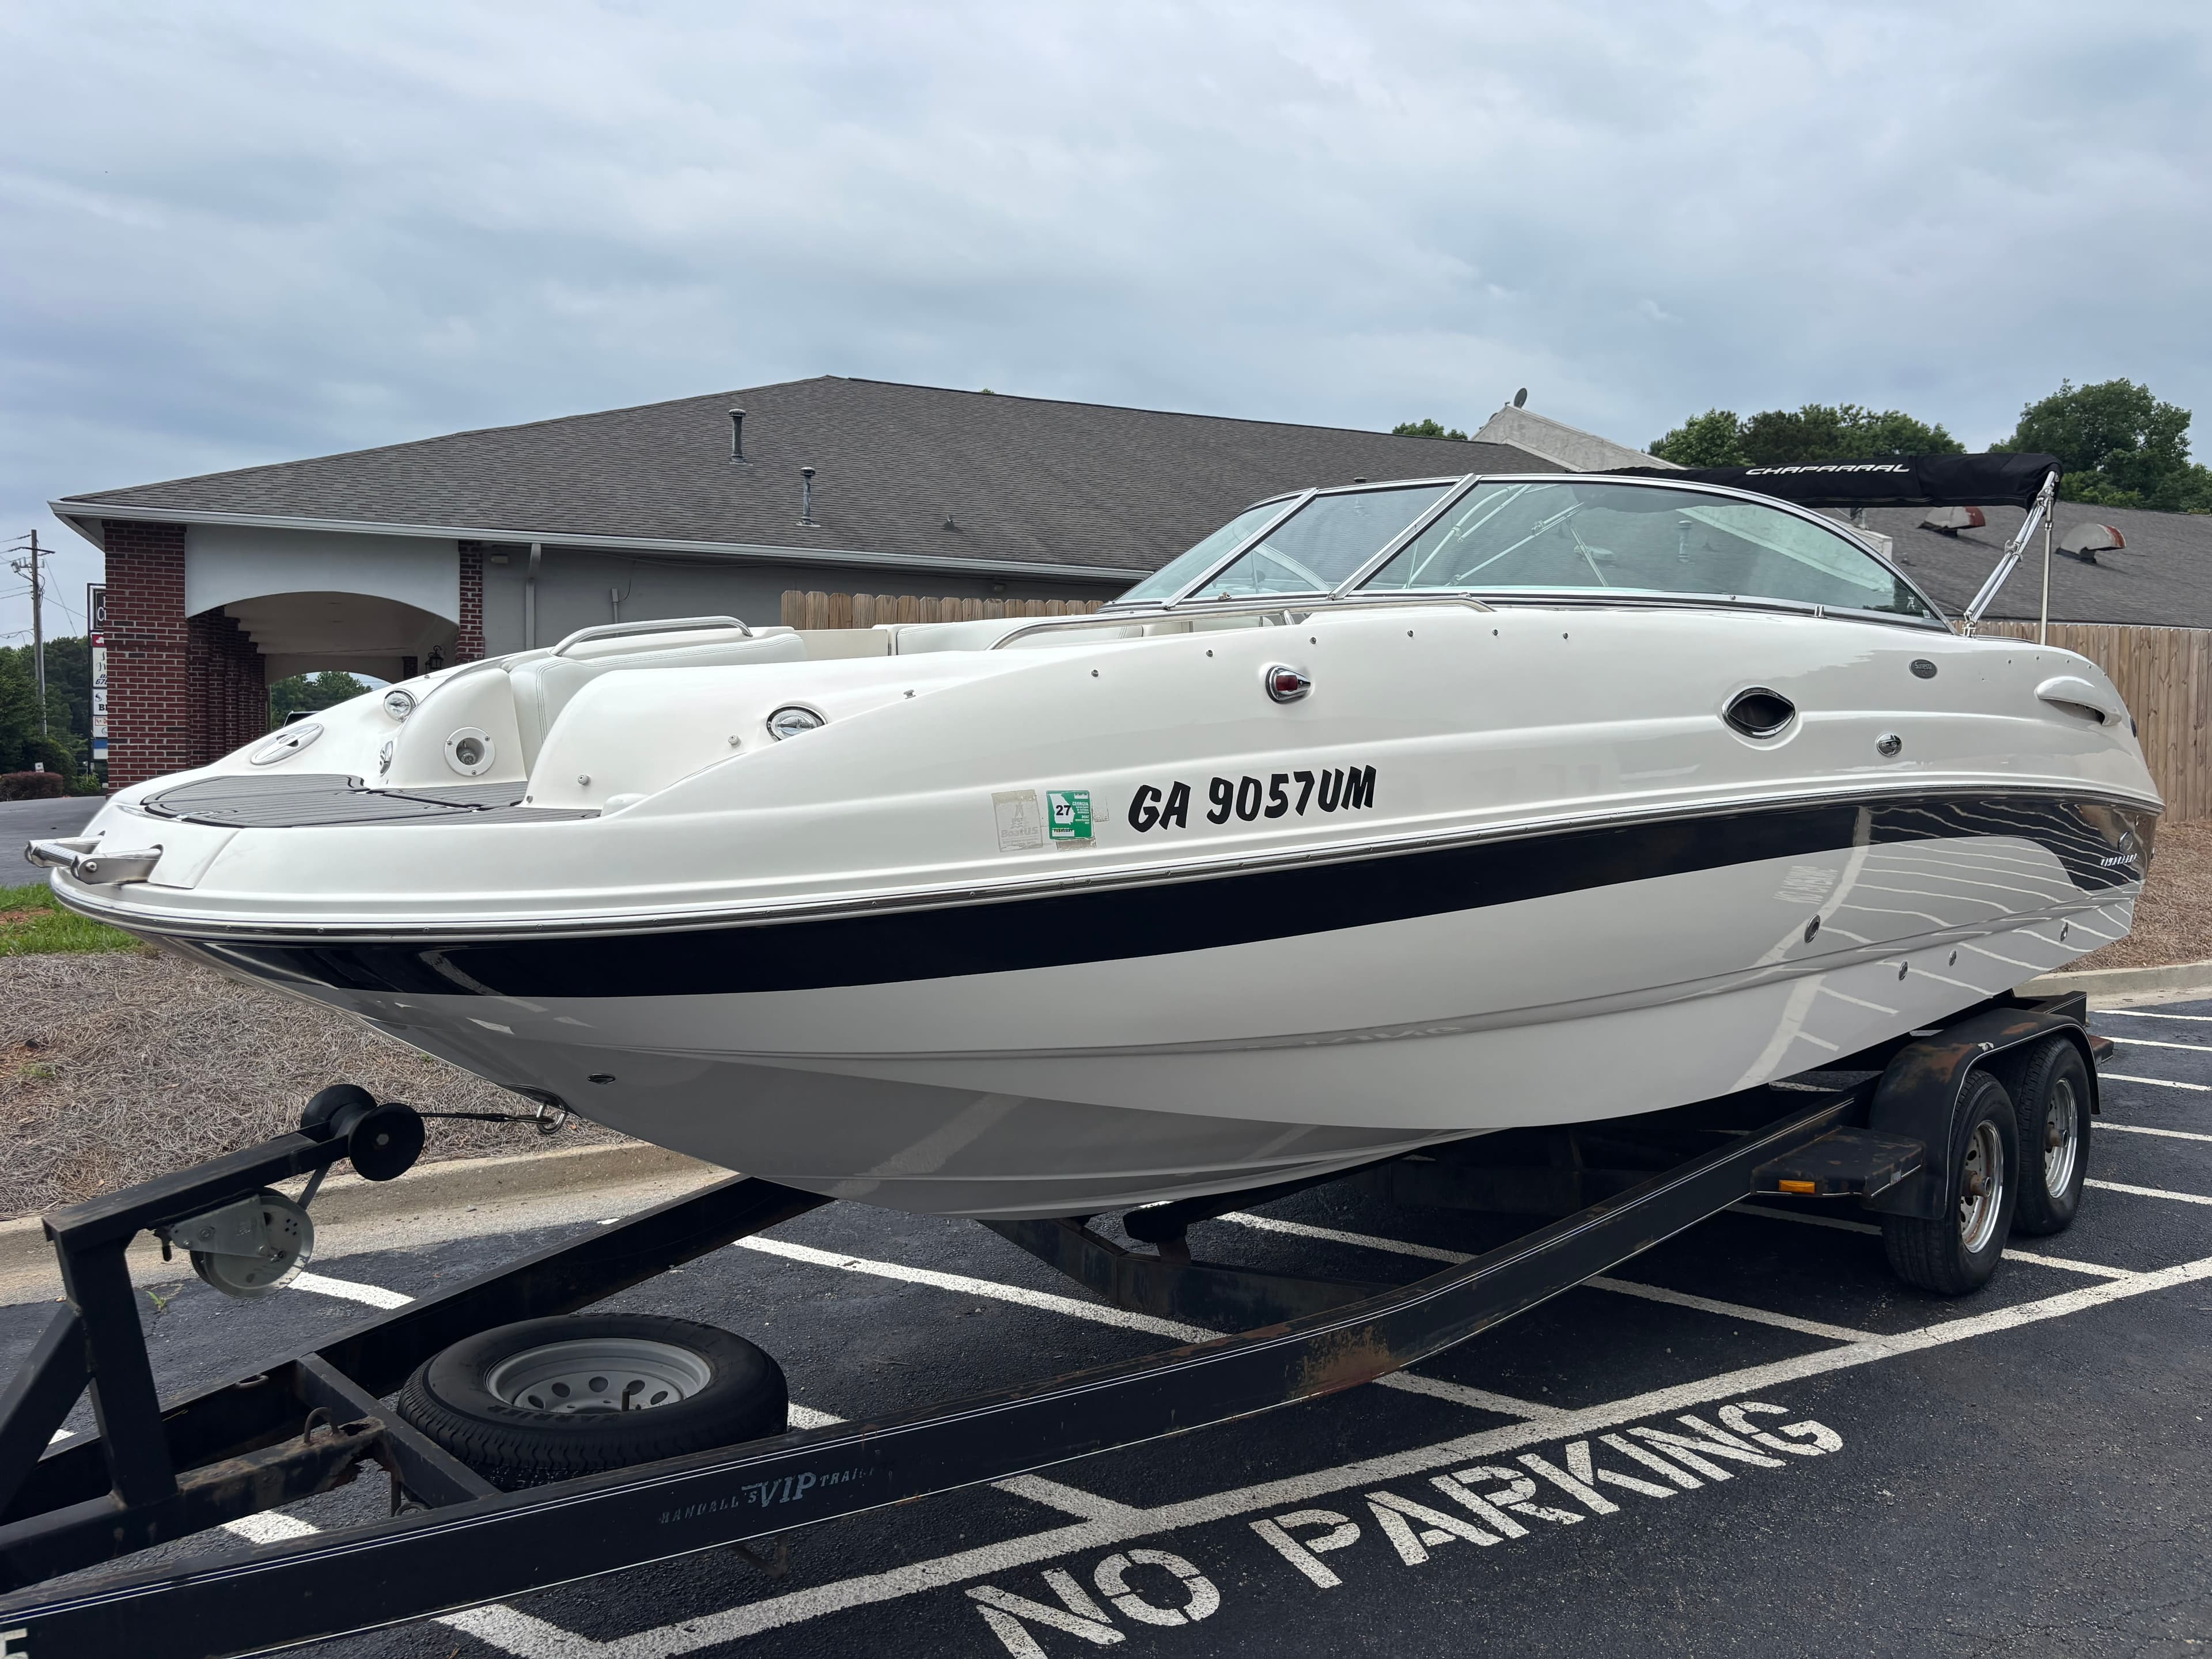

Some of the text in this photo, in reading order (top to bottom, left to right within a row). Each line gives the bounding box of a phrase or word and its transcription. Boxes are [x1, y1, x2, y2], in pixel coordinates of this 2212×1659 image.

[1745, 464, 1910, 476] CHAPARRAL
[1055, 805, 1071, 816] 27
[1128, 764, 1377, 833] GA 9057UM
[741, 1472, 817, 1508] VIP
[965, 1401, 1843, 1659] NO PARKING
